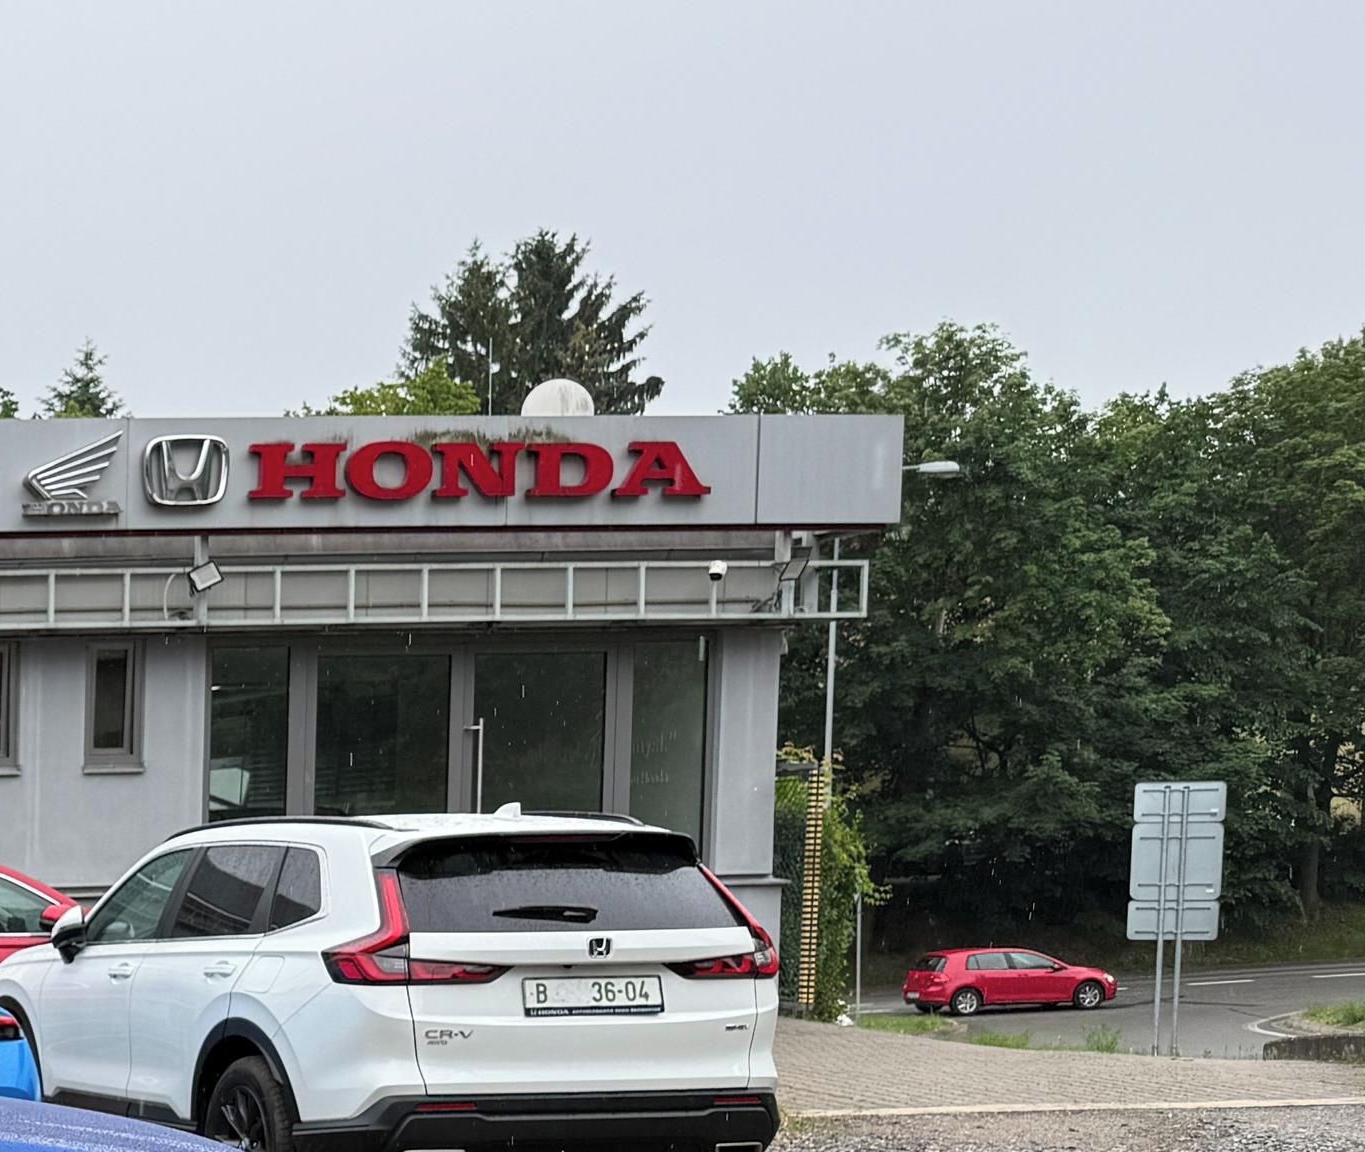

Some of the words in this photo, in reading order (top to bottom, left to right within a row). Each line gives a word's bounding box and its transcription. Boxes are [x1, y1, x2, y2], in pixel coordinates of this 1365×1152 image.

[248, 440, 712, 499] HONDA
[535, 982, 548, 1004] B
[591, 980, 650, 1003] 36-04
